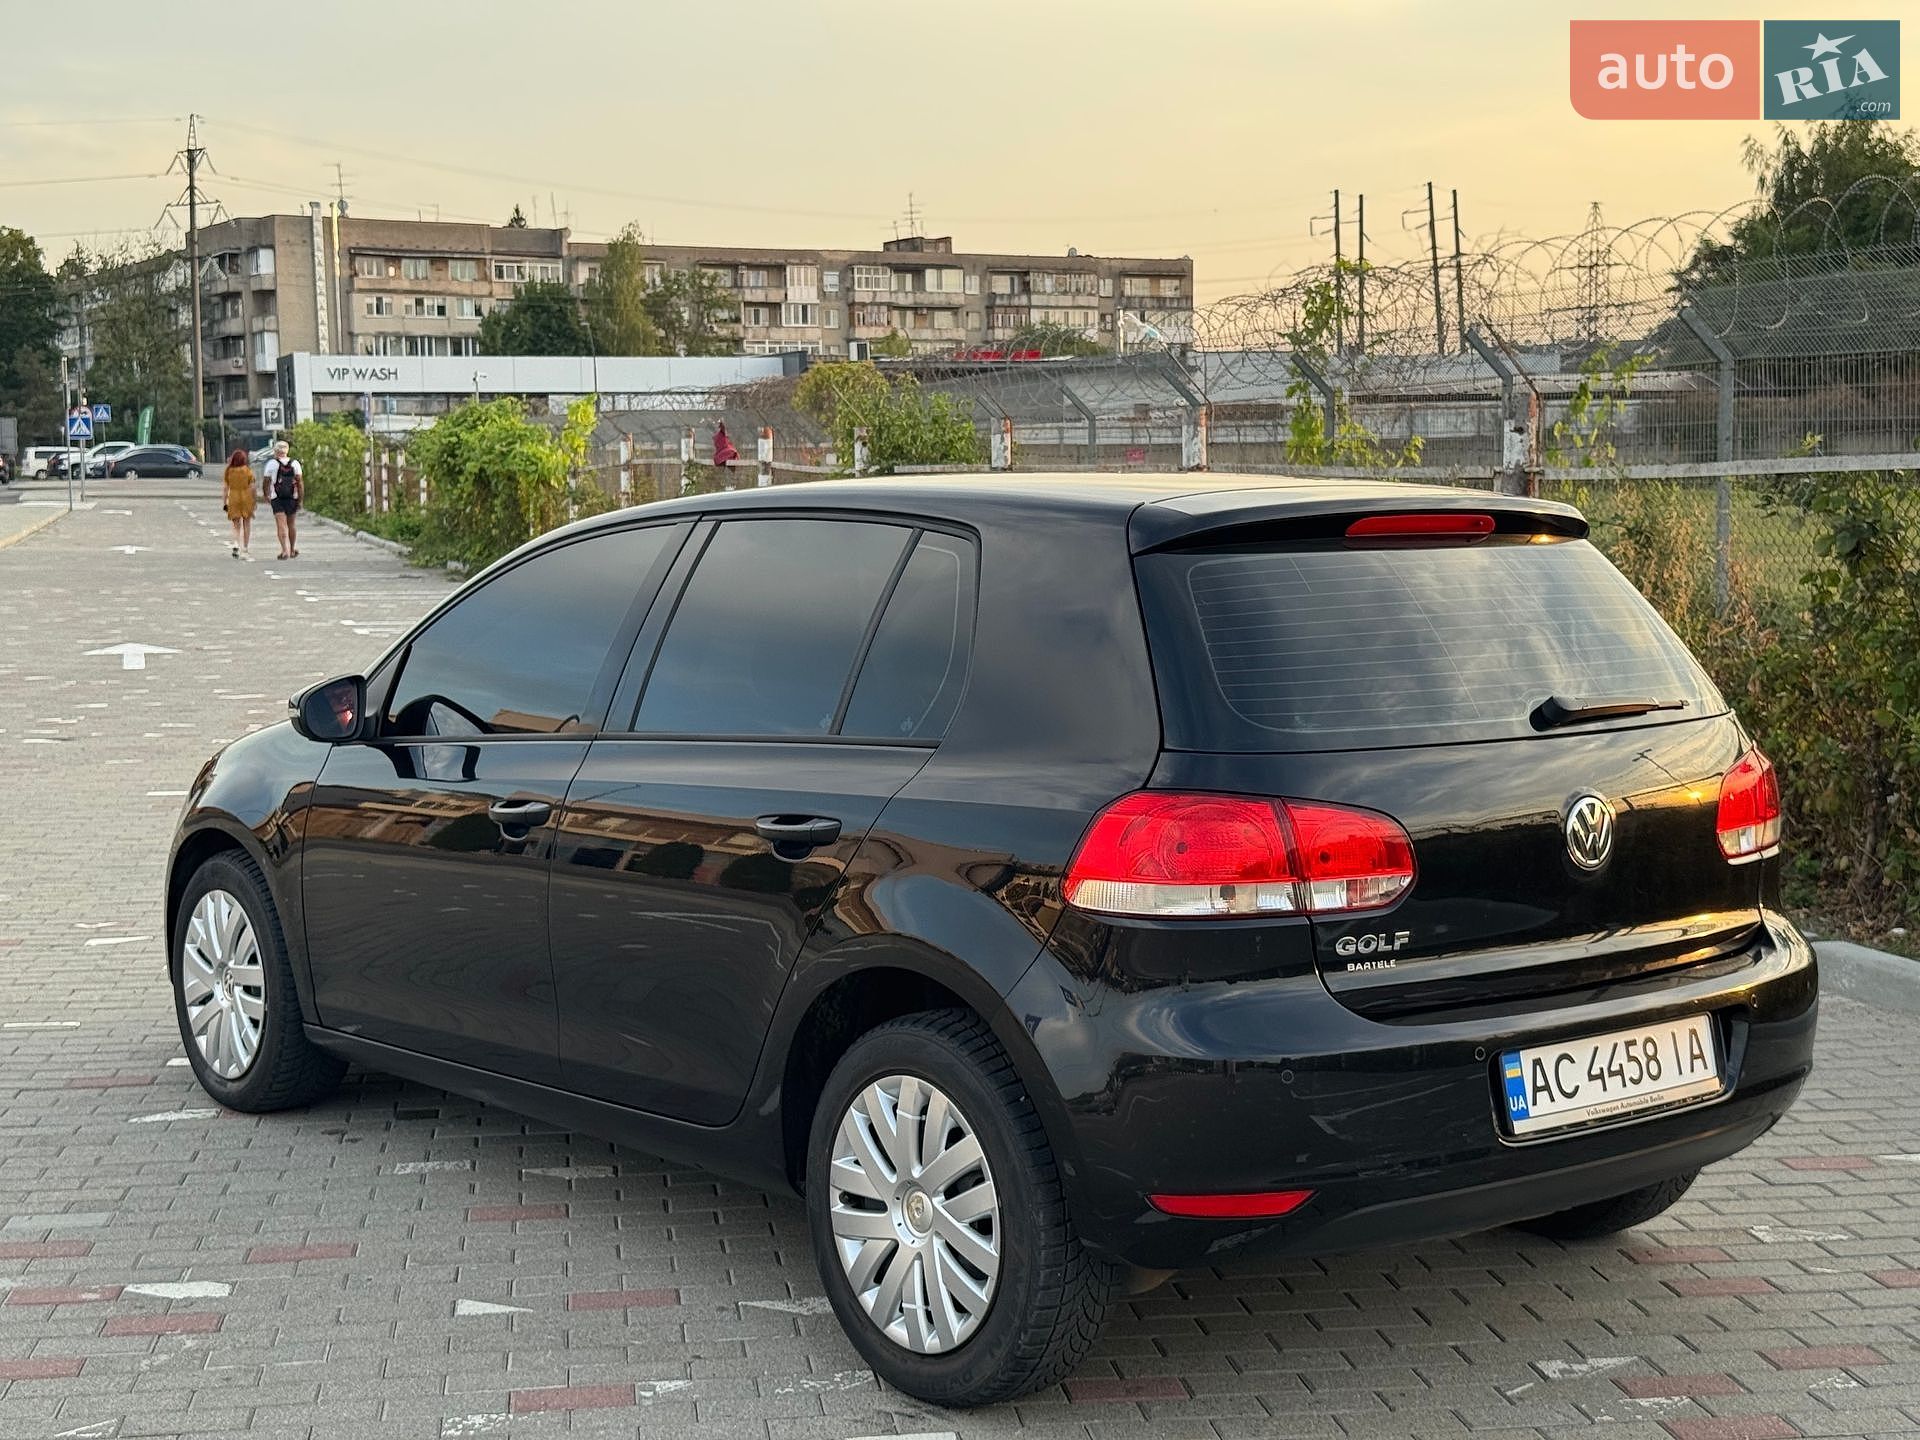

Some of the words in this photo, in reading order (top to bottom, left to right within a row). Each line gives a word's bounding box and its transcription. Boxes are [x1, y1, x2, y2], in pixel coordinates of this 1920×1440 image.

[327, 367, 349, 381] VIP
[353, 367, 398, 381] WASH
[1335, 930, 1411, 956] GOLF
[1531, 1052, 1580, 1107] AC
[1587, 1036, 1662, 1093] 4458
[1671, 1027, 1709, 1076] IA
[1509, 1094, 1528, 1112] UA
[1586, 1104, 1620, 1117] Volkswagen
